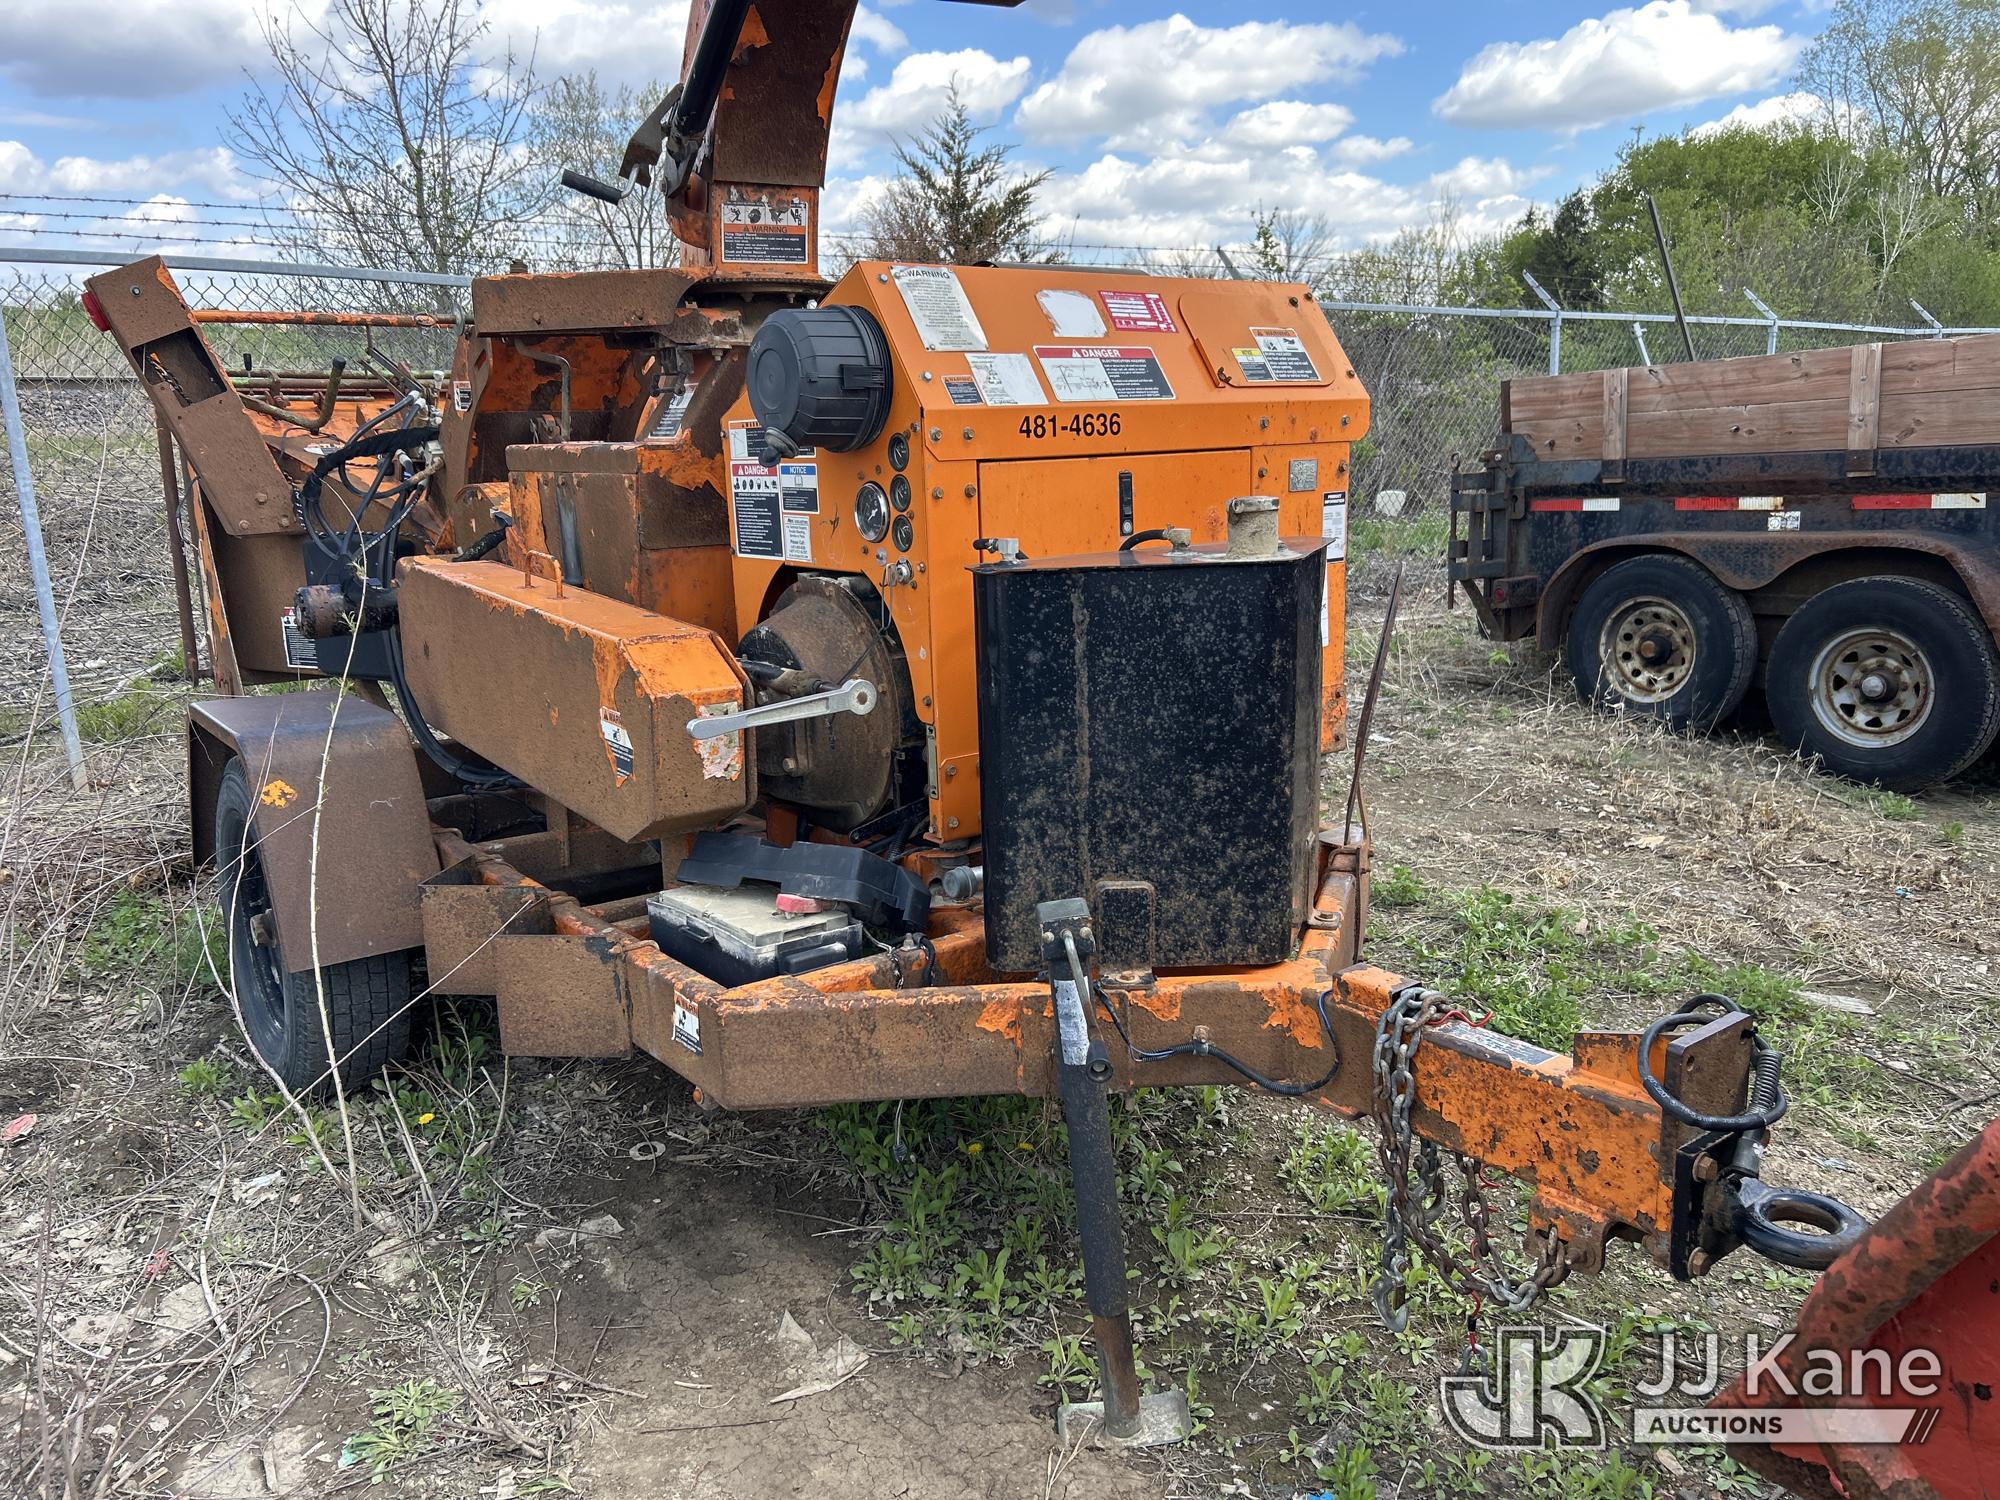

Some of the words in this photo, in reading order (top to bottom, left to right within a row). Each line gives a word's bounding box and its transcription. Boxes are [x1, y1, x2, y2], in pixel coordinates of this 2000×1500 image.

[751, 225, 788, 234] WARNING
[907, 269, 950, 279] WARNING
[1081, 349, 1121, 358] DANGER
[1019, 412, 1121, 438] 481-4636
[744, 466, 769, 475] DANGER
[789, 466, 807, 474] NOTICE
